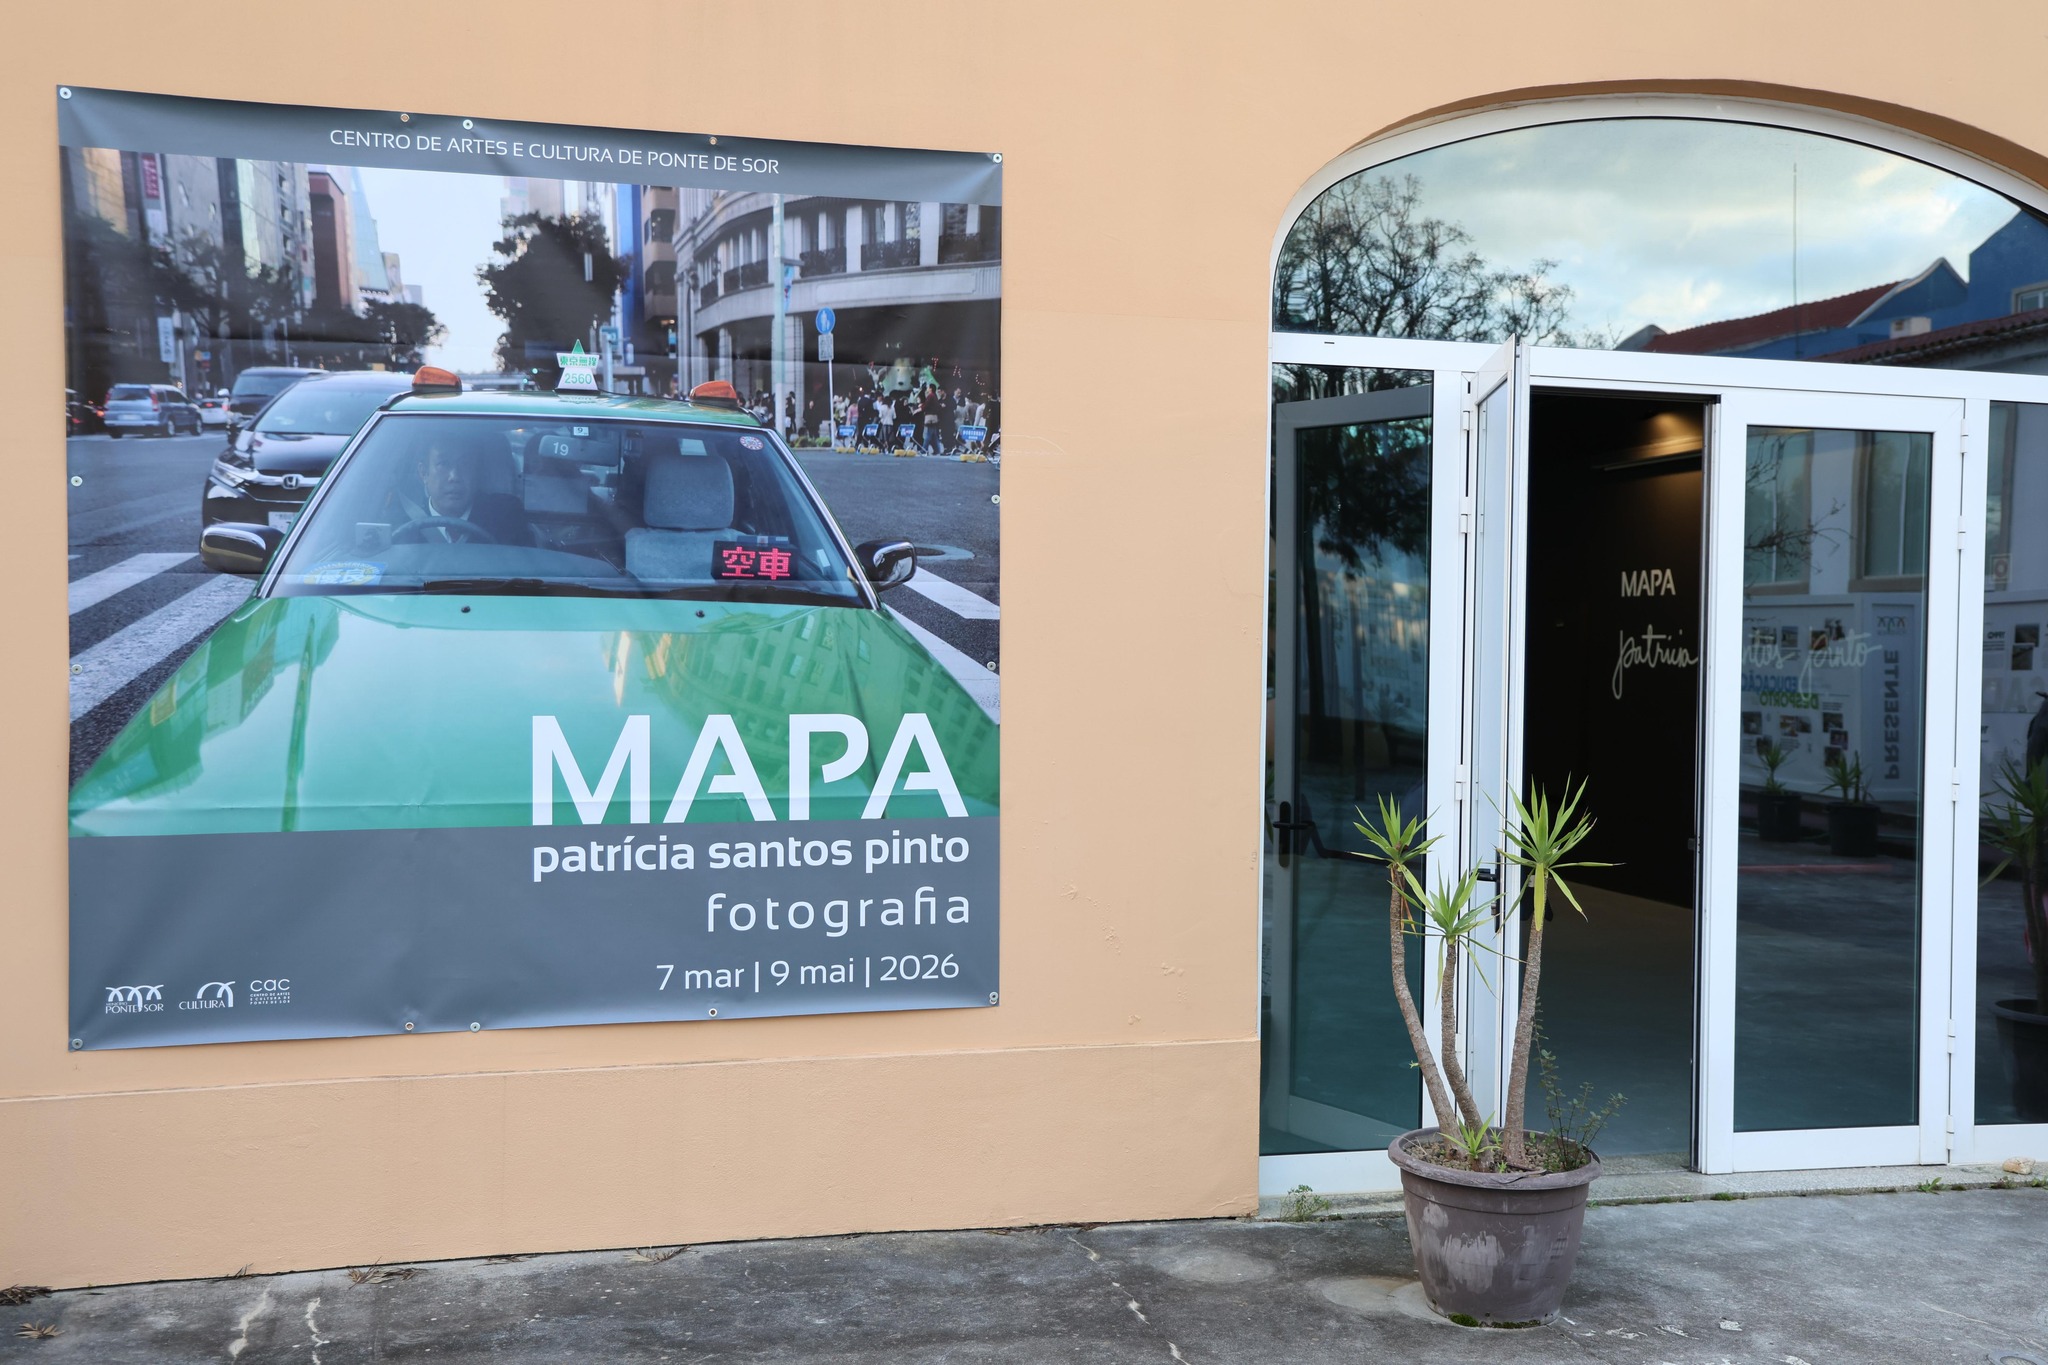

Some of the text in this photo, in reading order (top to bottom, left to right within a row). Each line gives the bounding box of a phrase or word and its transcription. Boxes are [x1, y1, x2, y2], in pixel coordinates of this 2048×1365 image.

[330, 130, 779, 174] CENTRO DE ARTES E CULTURA DE PONTE DE SOR
[565, 373, 592, 384] 2560
[553, 442, 568, 455] 19
[722, 547, 791, 580] 空車
[1621, 569, 1676, 597] MAPA
[532, 713, 968, 825] MAPA
[534, 830, 969, 882] patrícia santos pinto
[708, 887, 969, 937] fotografia
[250, 979, 290, 992] cac
[657, 965, 674, 990] 7
[685, 964, 745, 989] mar
[771, 960, 789, 985] 9
[800, 958, 854, 984] mai
[880, 953, 959, 981] 2026
[106, 1003, 163, 1014] PONTE SOR
[179, 1000, 225, 1010] CULTURA
